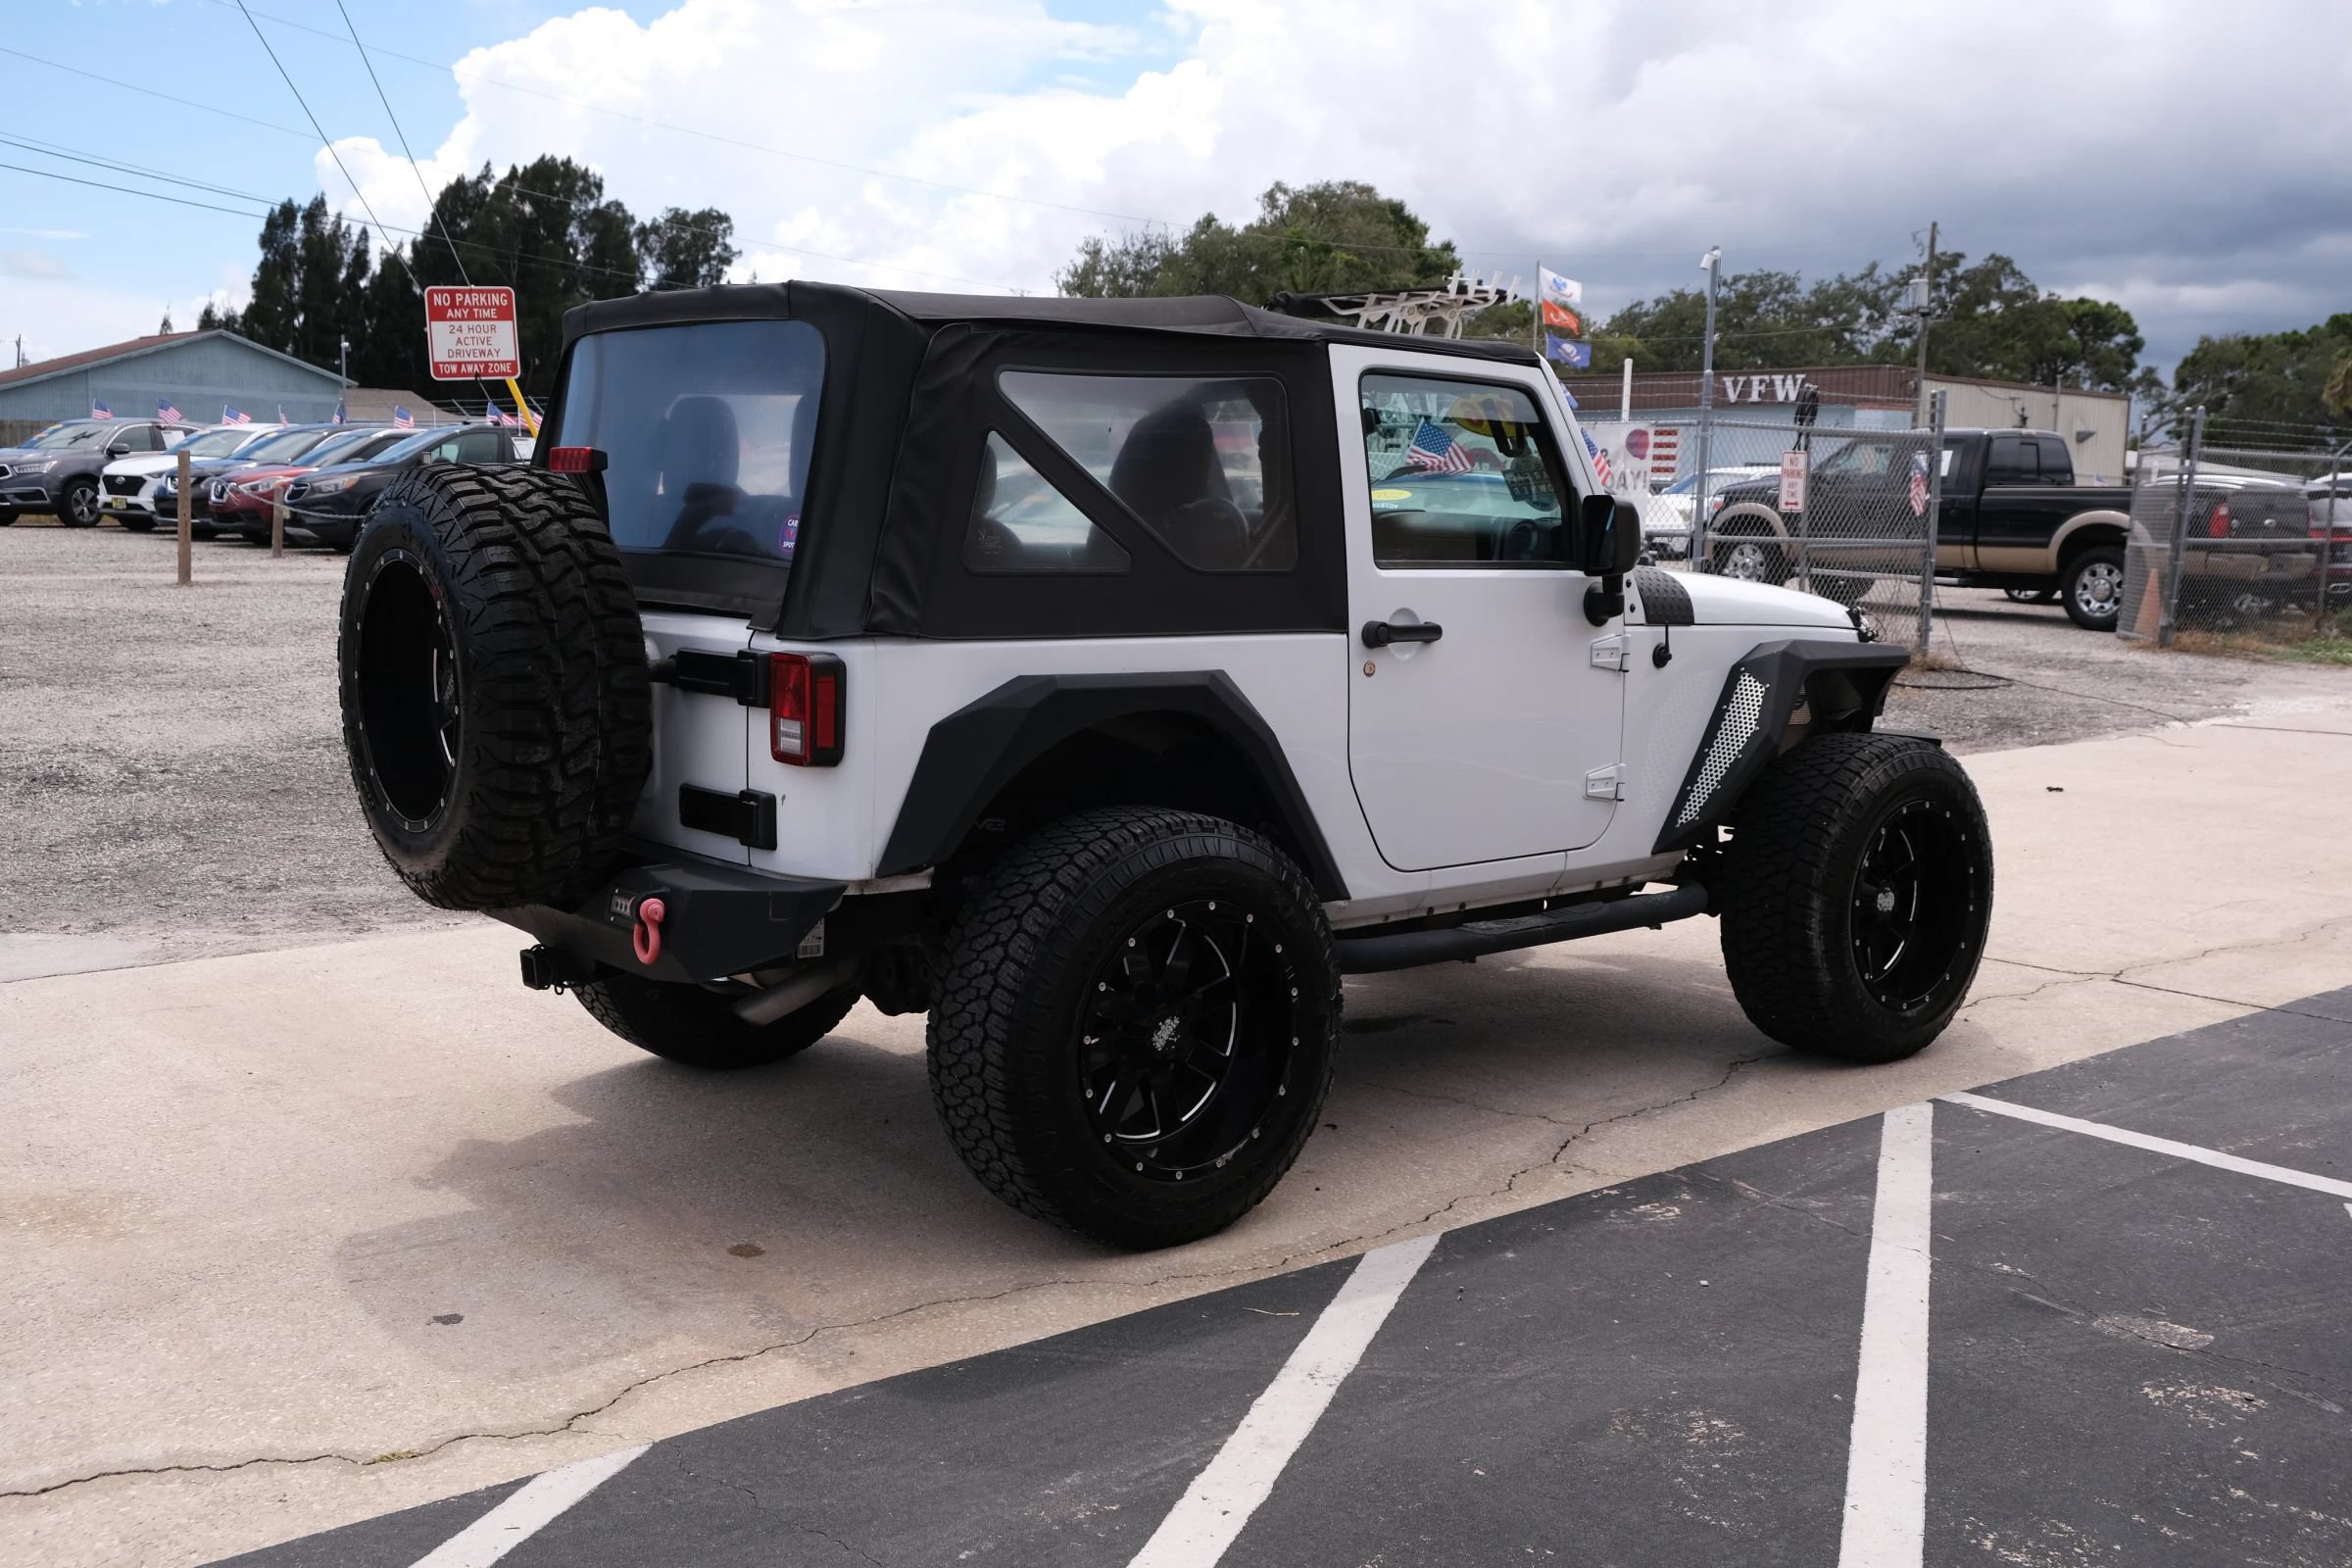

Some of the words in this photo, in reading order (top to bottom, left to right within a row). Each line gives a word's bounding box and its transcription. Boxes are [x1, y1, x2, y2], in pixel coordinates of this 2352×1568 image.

[433, 293, 451, 307] NO
[456, 292, 509, 307] PARKING
[447, 309, 468, 318] ANY
[472, 308, 498, 318] TIME
[449, 324, 463, 334] 24
[467, 324, 497, 334] HOUR
[456, 336, 493, 346] ACTIVE
[448, 348, 501, 359] DRIVEWAY
[439, 364, 458, 374] TOW
[461, 364, 485, 373] AWAY
[488, 363, 512, 372] ZONE
[1723, 374, 1806, 403] VFW
[1789, 457, 1799, 467] NO
[1784, 468, 1803, 479] PARKING
[1787, 490, 1797, 499] TIME
